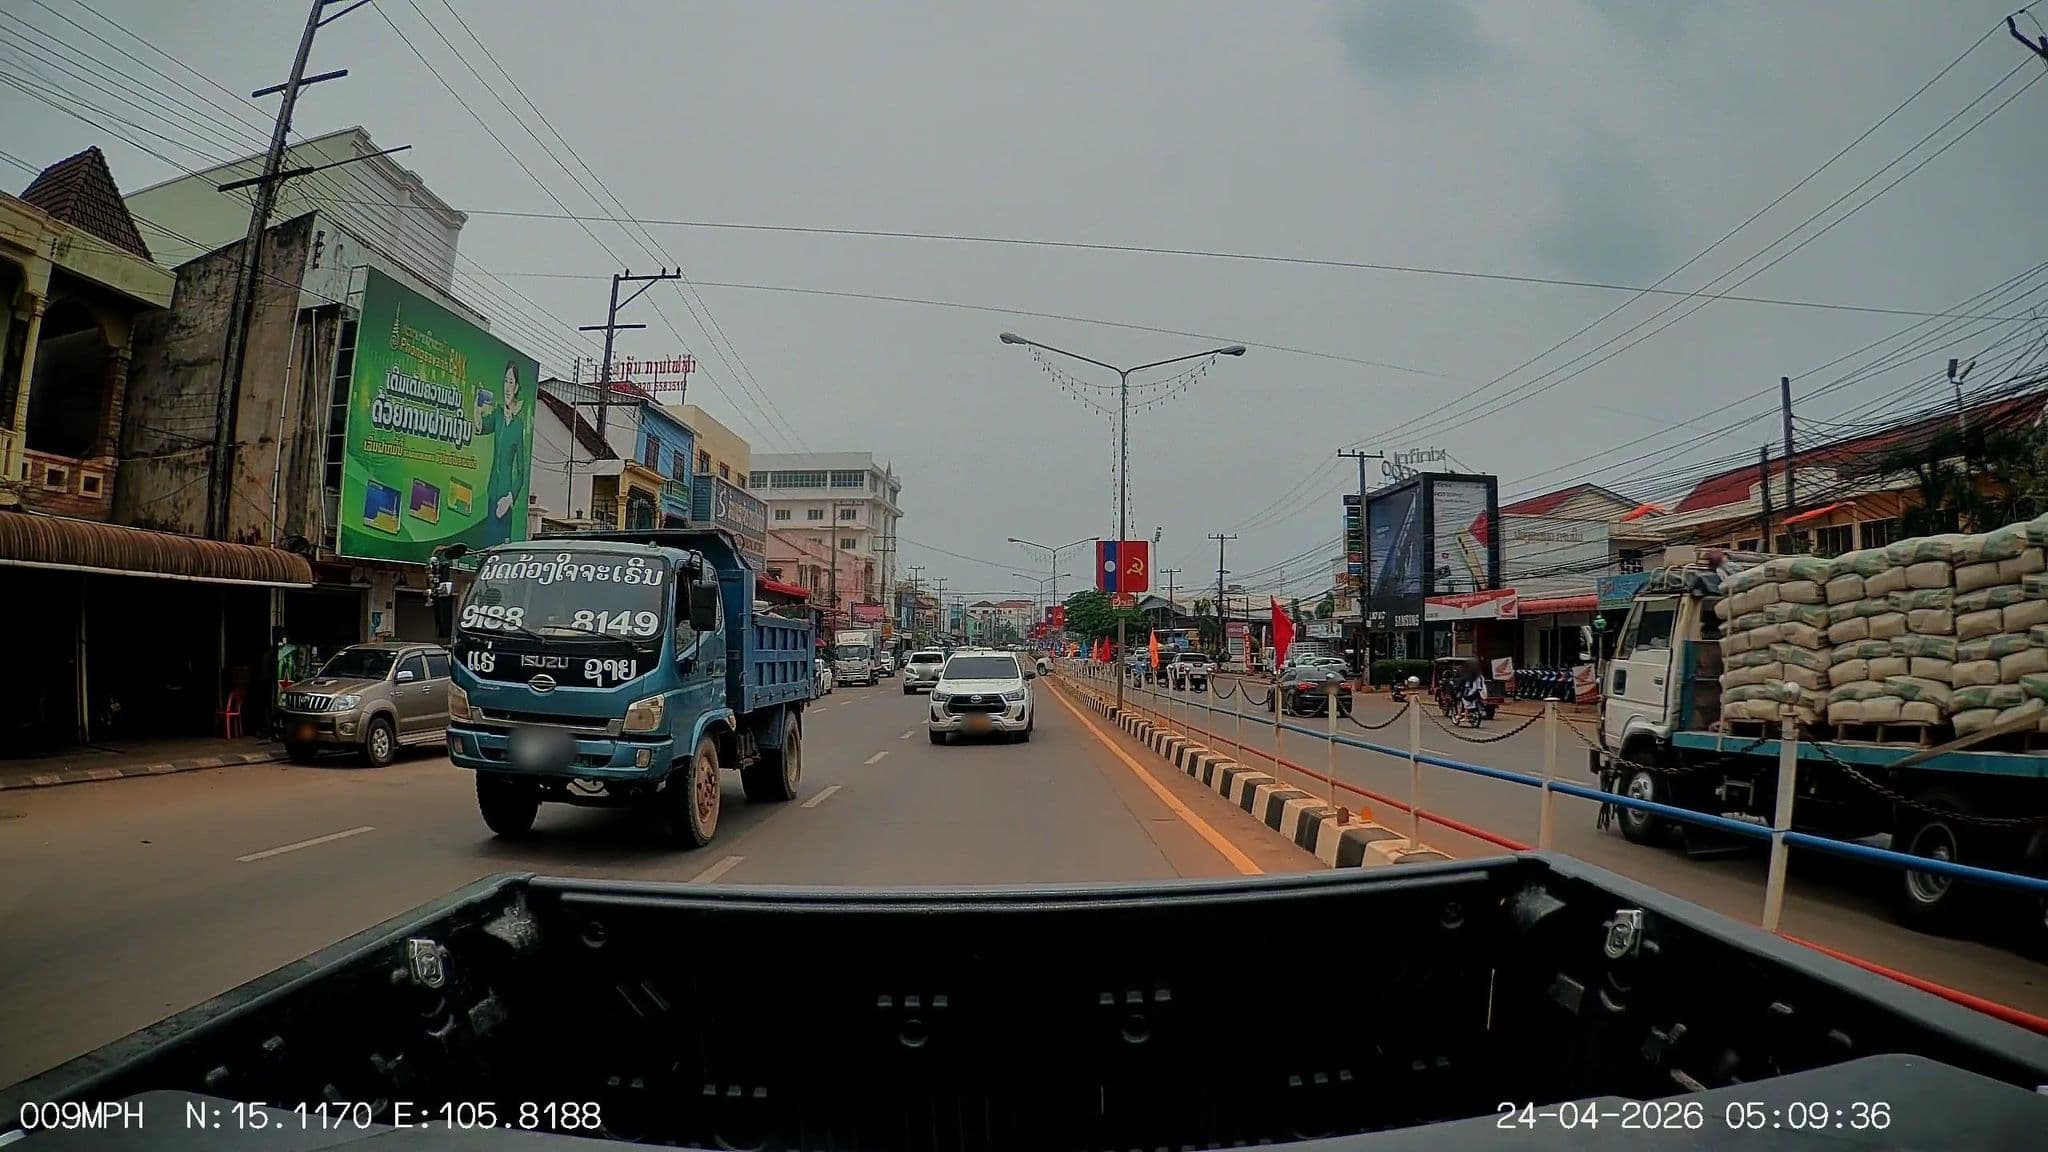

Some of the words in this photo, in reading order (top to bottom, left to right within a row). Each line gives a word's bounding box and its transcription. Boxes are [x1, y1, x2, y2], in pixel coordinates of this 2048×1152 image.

[461, 604, 525, 631] 9188
[571, 609, 659, 637] 8149
[521, 654, 569, 669] ISUZU
